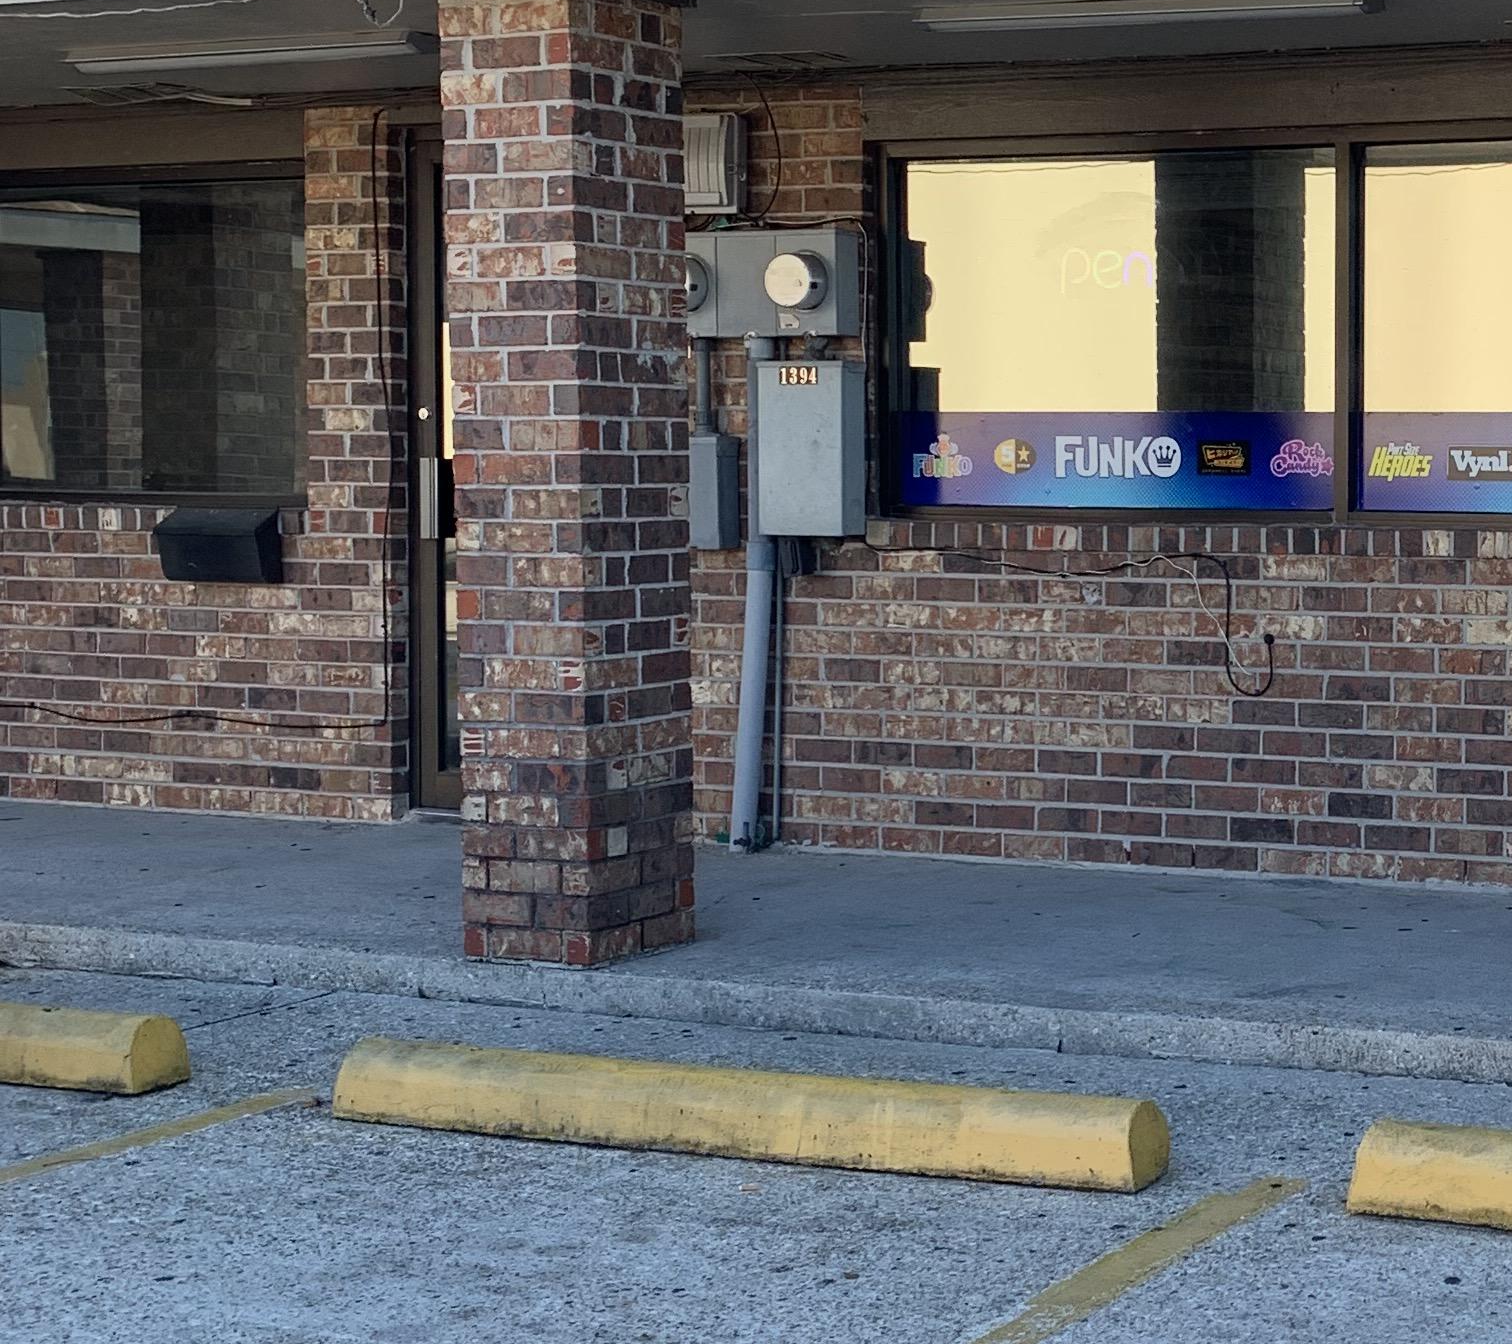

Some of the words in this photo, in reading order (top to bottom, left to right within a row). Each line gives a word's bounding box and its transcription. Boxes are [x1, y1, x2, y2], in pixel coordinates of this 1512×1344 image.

[780, 366, 818, 385] 1394
[1055, 435, 1182, 478] FUNKO
[1280, 439, 1326, 462] Rock
[912, 453, 973, 478] FUNKO
[1368, 446, 1433, 482] HEROES
